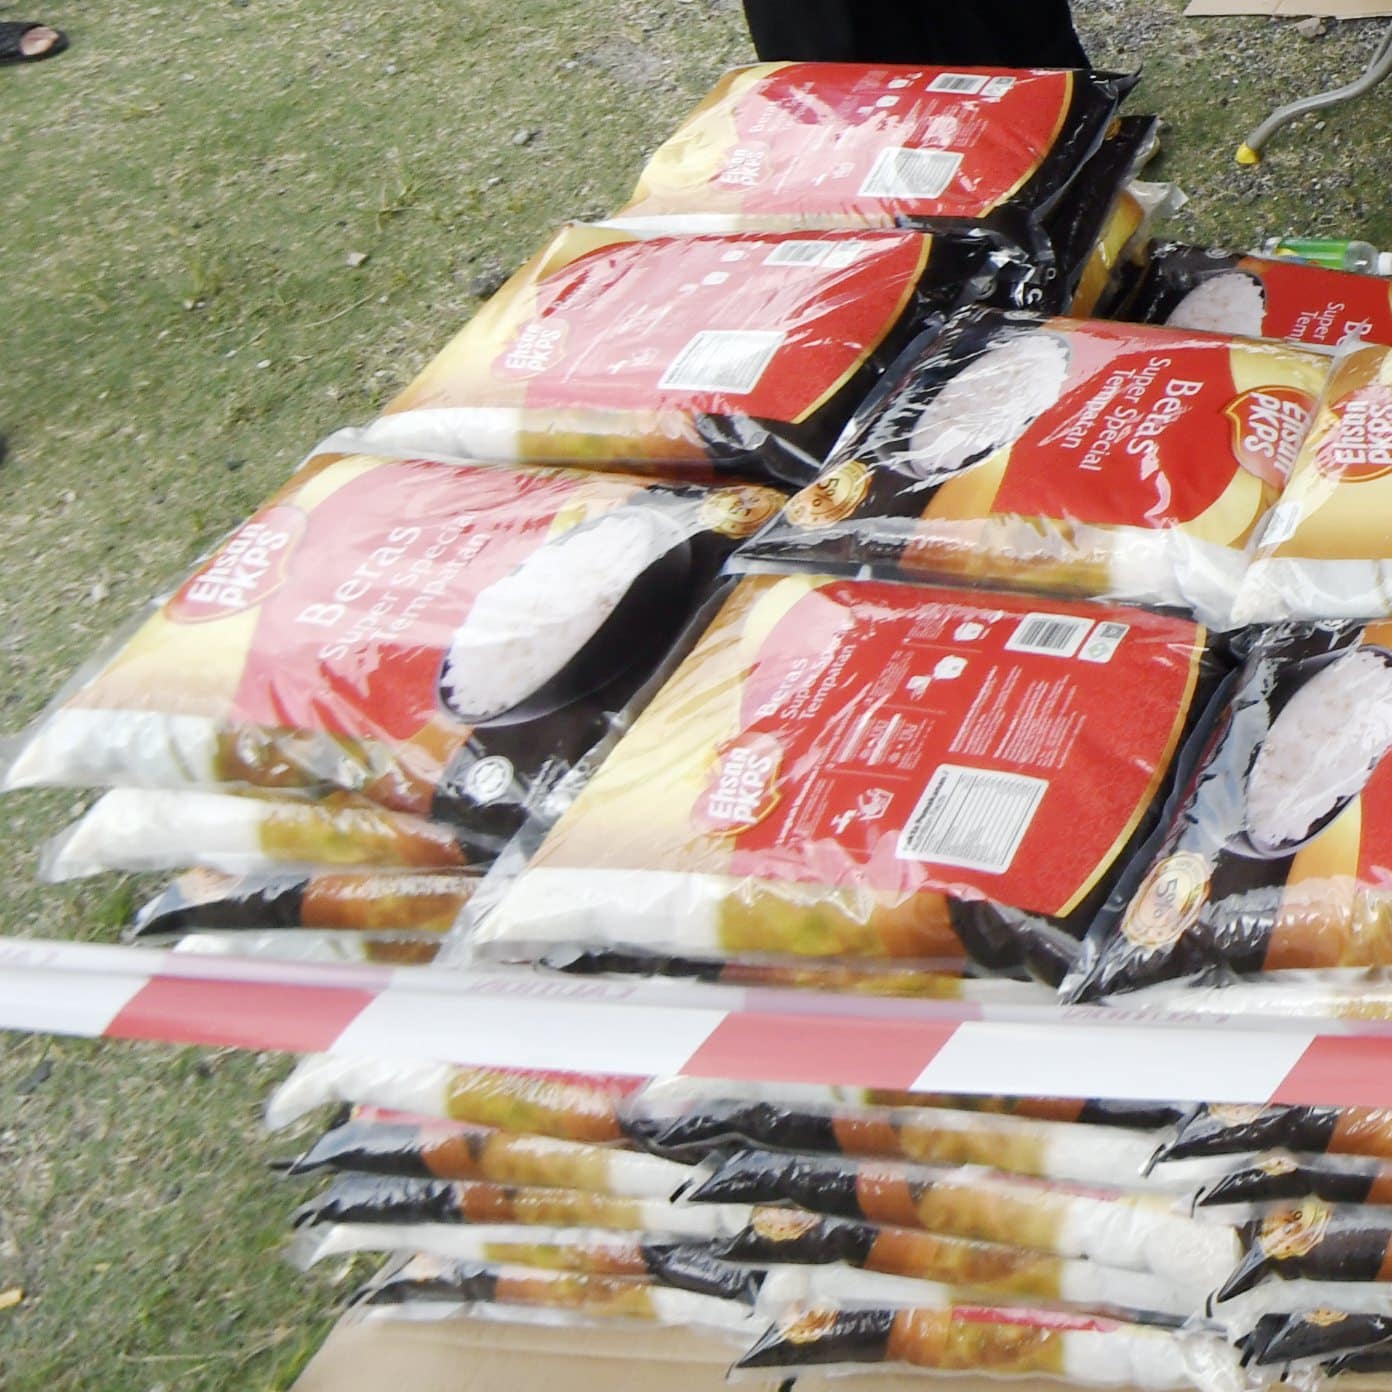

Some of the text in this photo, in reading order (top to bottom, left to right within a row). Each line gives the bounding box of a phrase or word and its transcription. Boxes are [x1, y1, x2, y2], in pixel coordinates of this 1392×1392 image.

[504, 323, 543, 370] Ehsan
[528, 328, 561, 372] PKPS
[1312, 301, 1345, 341] Super
[1060, 368, 1137, 449] Tempatan
[1078, 356, 1172, 472] Super Special
[1126, 378, 1205, 456] Beras
[1242, 391, 1280, 458] PKPS
[1273, 400, 1309, 474] Ehsan
[1333, 400, 1370, 465] Ehsan
[185, 521, 268, 603] Ehsan
[216, 530, 290, 608] PKPS
[294, 525, 423, 628] Beras
[369, 532, 491, 641] Tempatan
[318, 591, 399, 659] Super
[755, 657, 810, 719] Beras
[799, 643, 858, 720] Tempatan
[707, 746, 751, 820] Ehsan
[731, 752, 774, 825] PKPS
